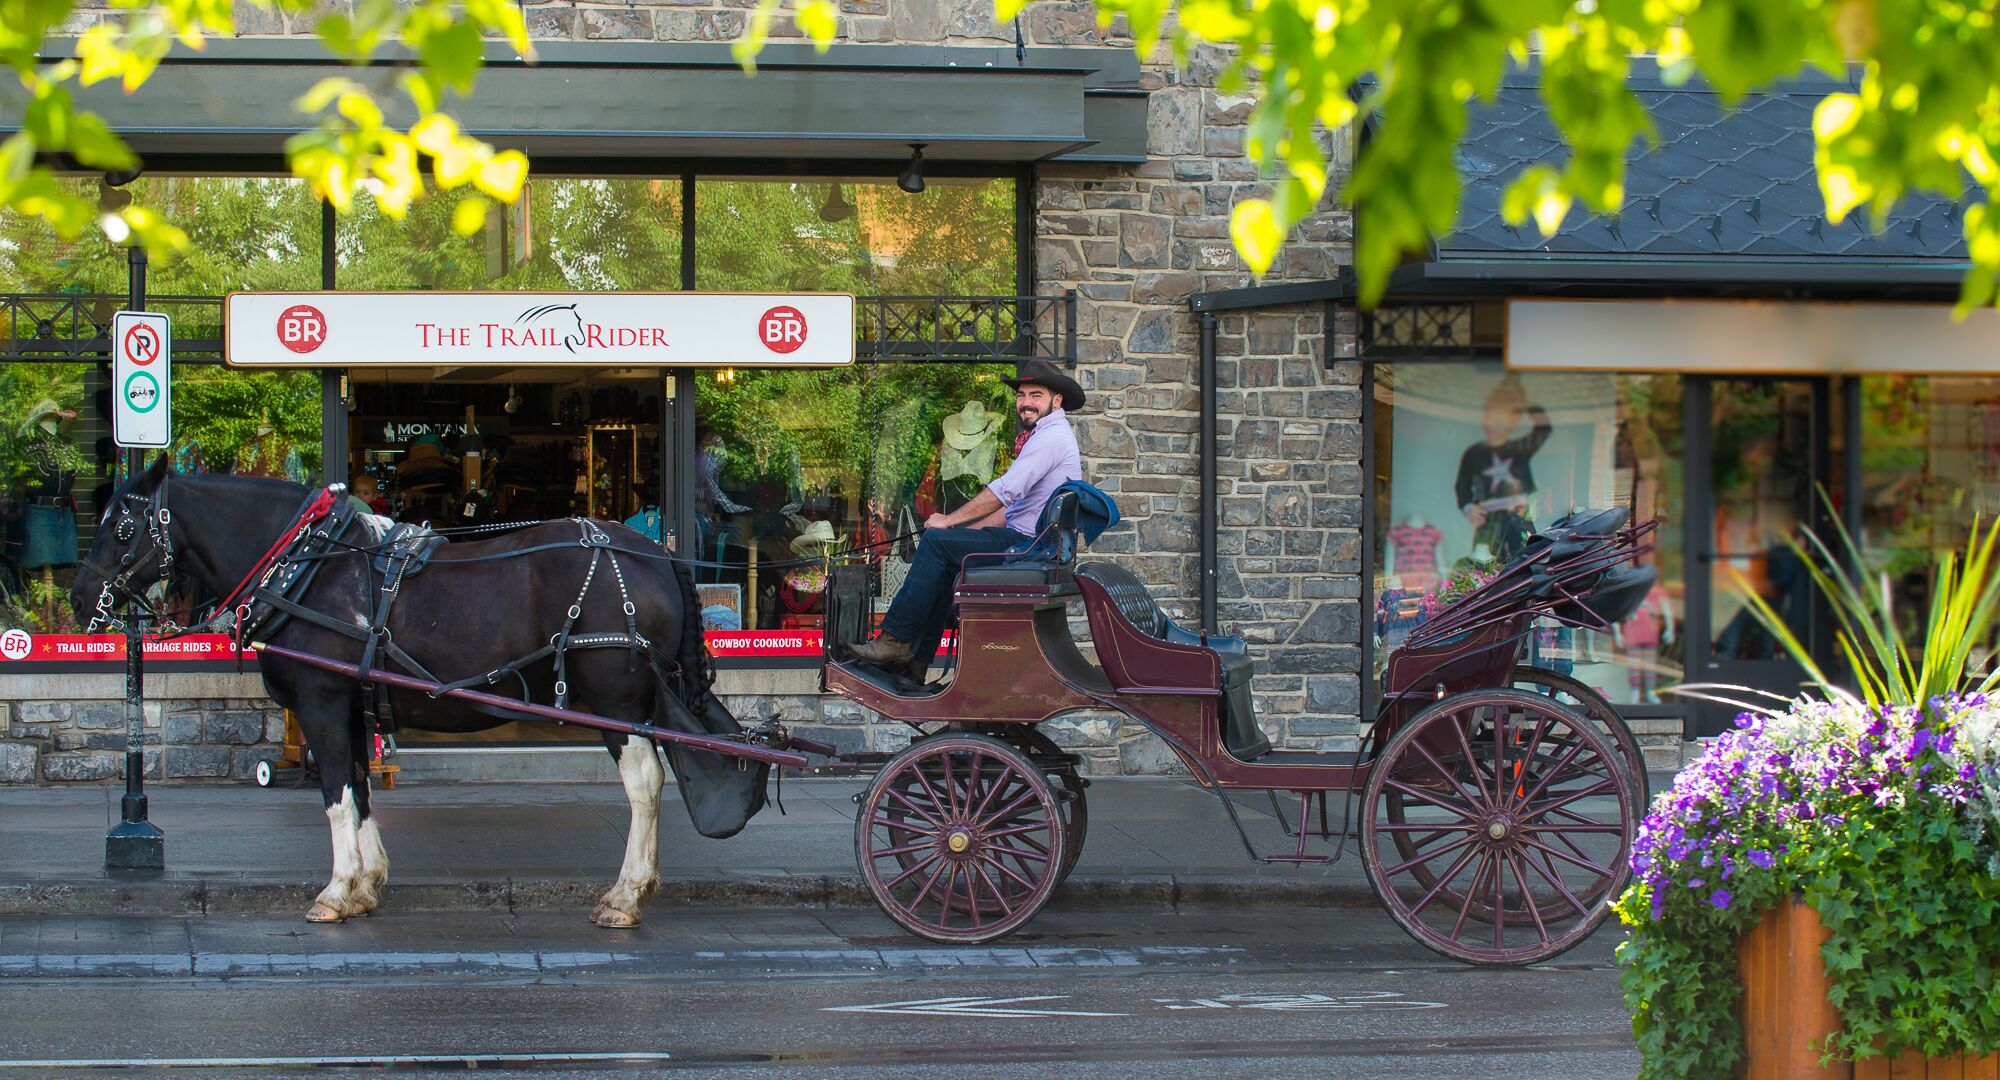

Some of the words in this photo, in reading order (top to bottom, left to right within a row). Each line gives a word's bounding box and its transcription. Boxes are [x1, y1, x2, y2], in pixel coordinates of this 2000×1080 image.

[415, 323, 471, 348] THE
[479, 323, 562, 348] TRAIL
[585, 323, 671, 348] RIDER
[56, 643, 85, 653] TRAIL
[87, 643, 115, 653] RIDES
[142, 642, 181, 652] ARRIAGE
[182, 642, 211, 652] RIDES
[712, 638, 751, 648] COWBOY
[753, 638, 802, 648] COOKOUTS
